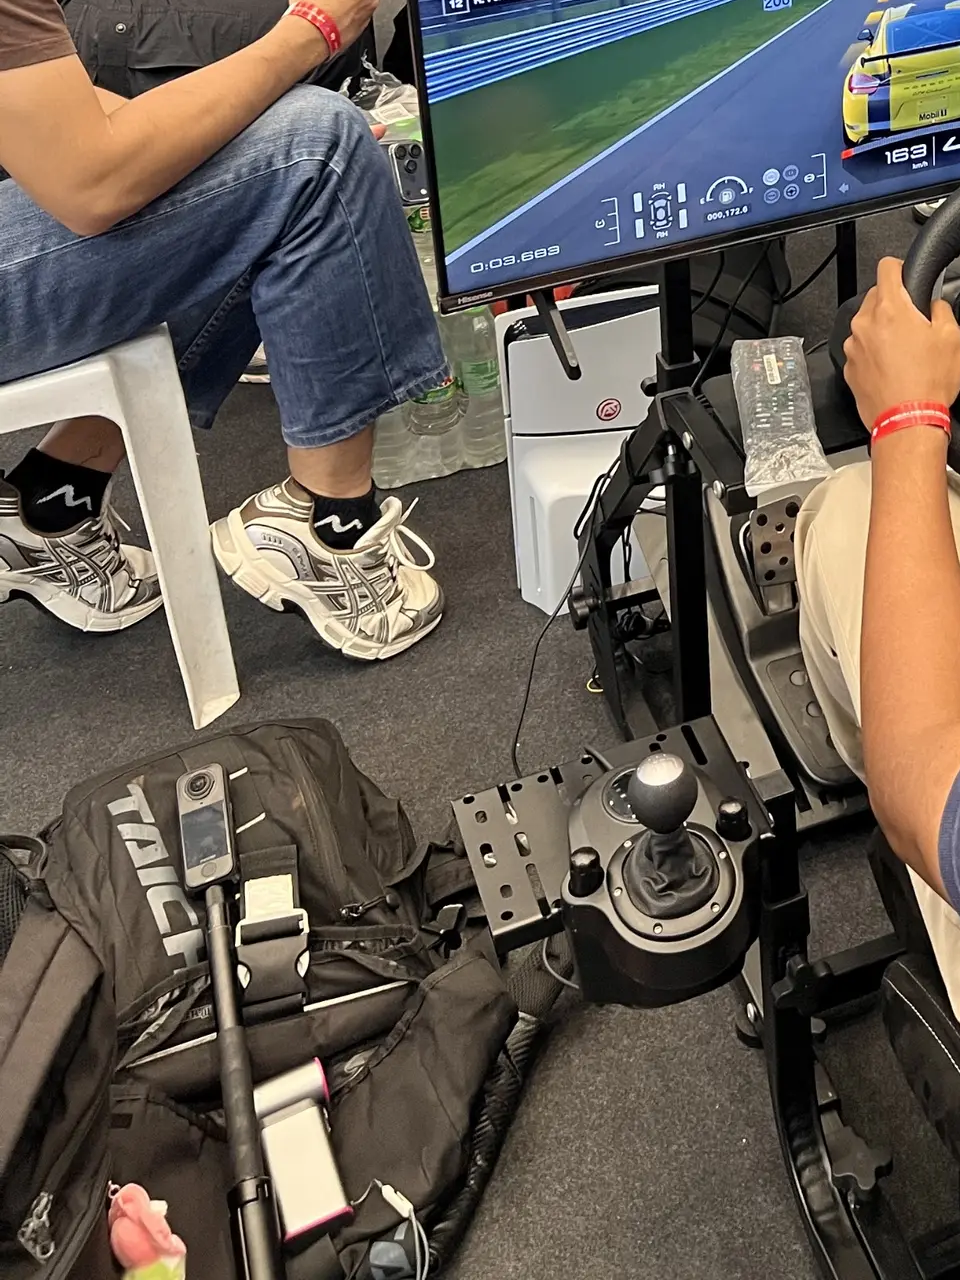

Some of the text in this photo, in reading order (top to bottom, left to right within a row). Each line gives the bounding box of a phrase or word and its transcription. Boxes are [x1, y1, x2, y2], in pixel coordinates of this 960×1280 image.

[918, 110, 939, 122] Mobil
[470, 245, 561, 273] 0:03.683
[457, 291, 494, 305] Hisense
